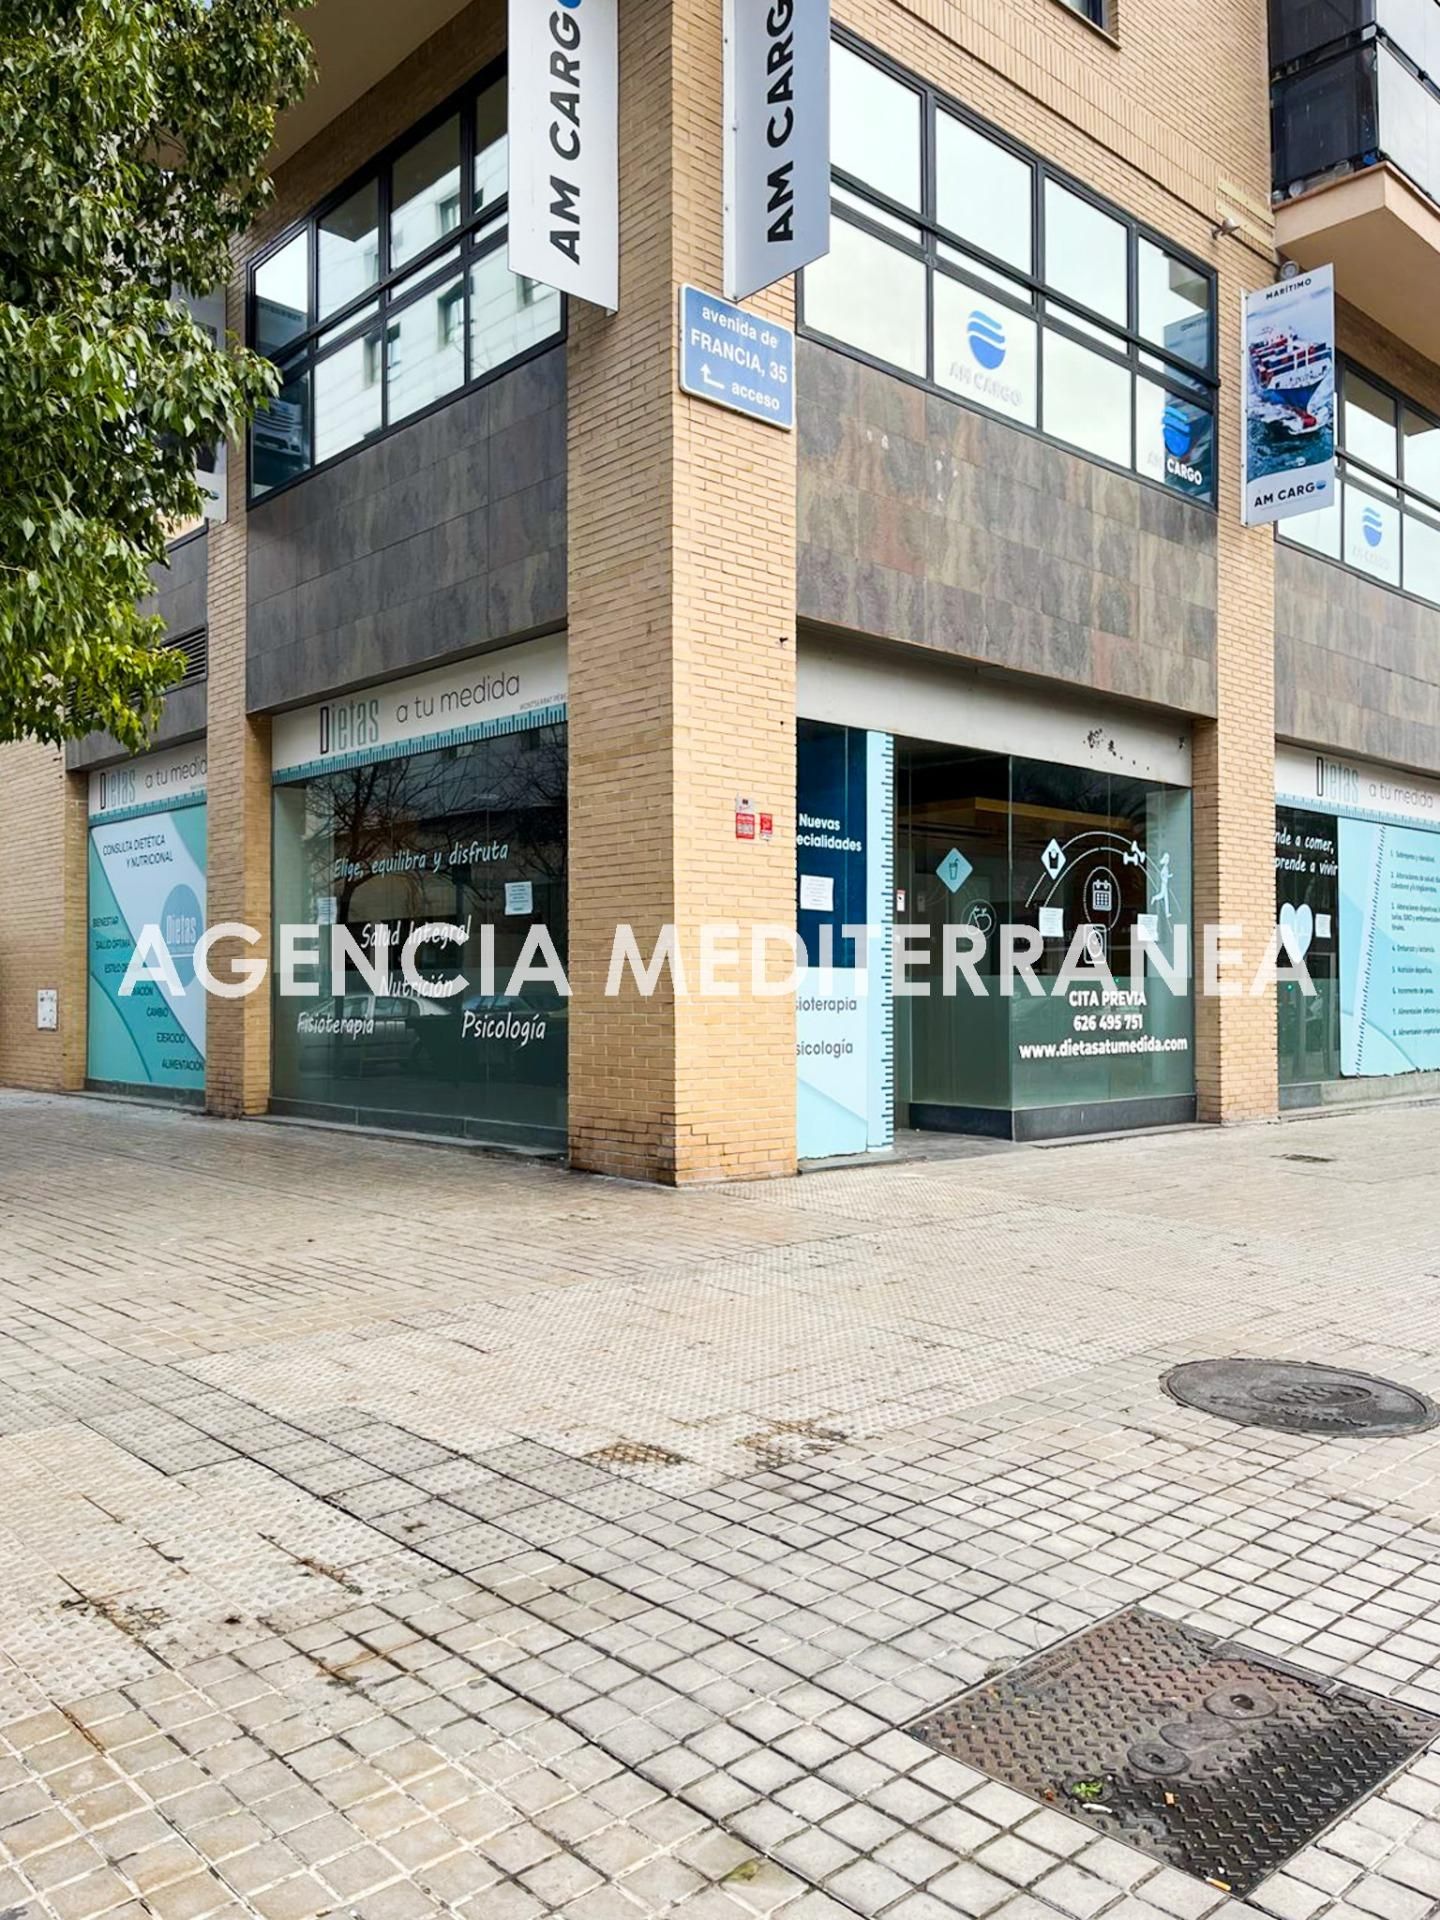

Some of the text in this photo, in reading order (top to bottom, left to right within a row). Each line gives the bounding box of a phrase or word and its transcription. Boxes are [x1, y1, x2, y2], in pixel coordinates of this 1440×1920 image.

[549, 0, 581, 265] AM CARG
[766, 0, 794, 243] AM CARG
[1265, 278, 1312, 300] MARÍTIMO
[702, 306, 778, 349] avenida de
[690, 328, 788, 384] FRANCIA, 35
[731, 382, 780, 411] acceso
[1167, 458, 1202, 485] CARGO
[1254, 493, 1274, 508] AM
[319, 672, 520, 755] Dietas a tu medida
[100, 769, 136, 810] Dietas
[145, 774, 153, 789] a
[156, 769, 168, 786] tu
[1316, 756, 1433, 809] Dietas a tu medida
[799, 813, 840, 831] Nuevas
[797, 833, 862, 852] ecialidades
[1295, 835, 1301, 847] a
[1304, 836, 1334, 855] comer,
[334, 840, 508, 881] Elige, equilibra y disfruta
[1275, 853, 1338, 876] prende a vivir
[166, 915, 197, 945] Dietas
[361, 915, 472, 949] Salud Integral
[379, 973, 454, 998] Nutrición
[1069, 990, 1147, 1007] CITA PREVIA
[297, 1011, 374, 1040] Fisioterapia
[461, 1010, 546, 1046] Psicología
[1073, 1014, 1143, 1031] 626 495 751
[796, 1038, 853, 1058] sicología
[1019, 1035, 1188, 1059] www.dietasatumedida.com
